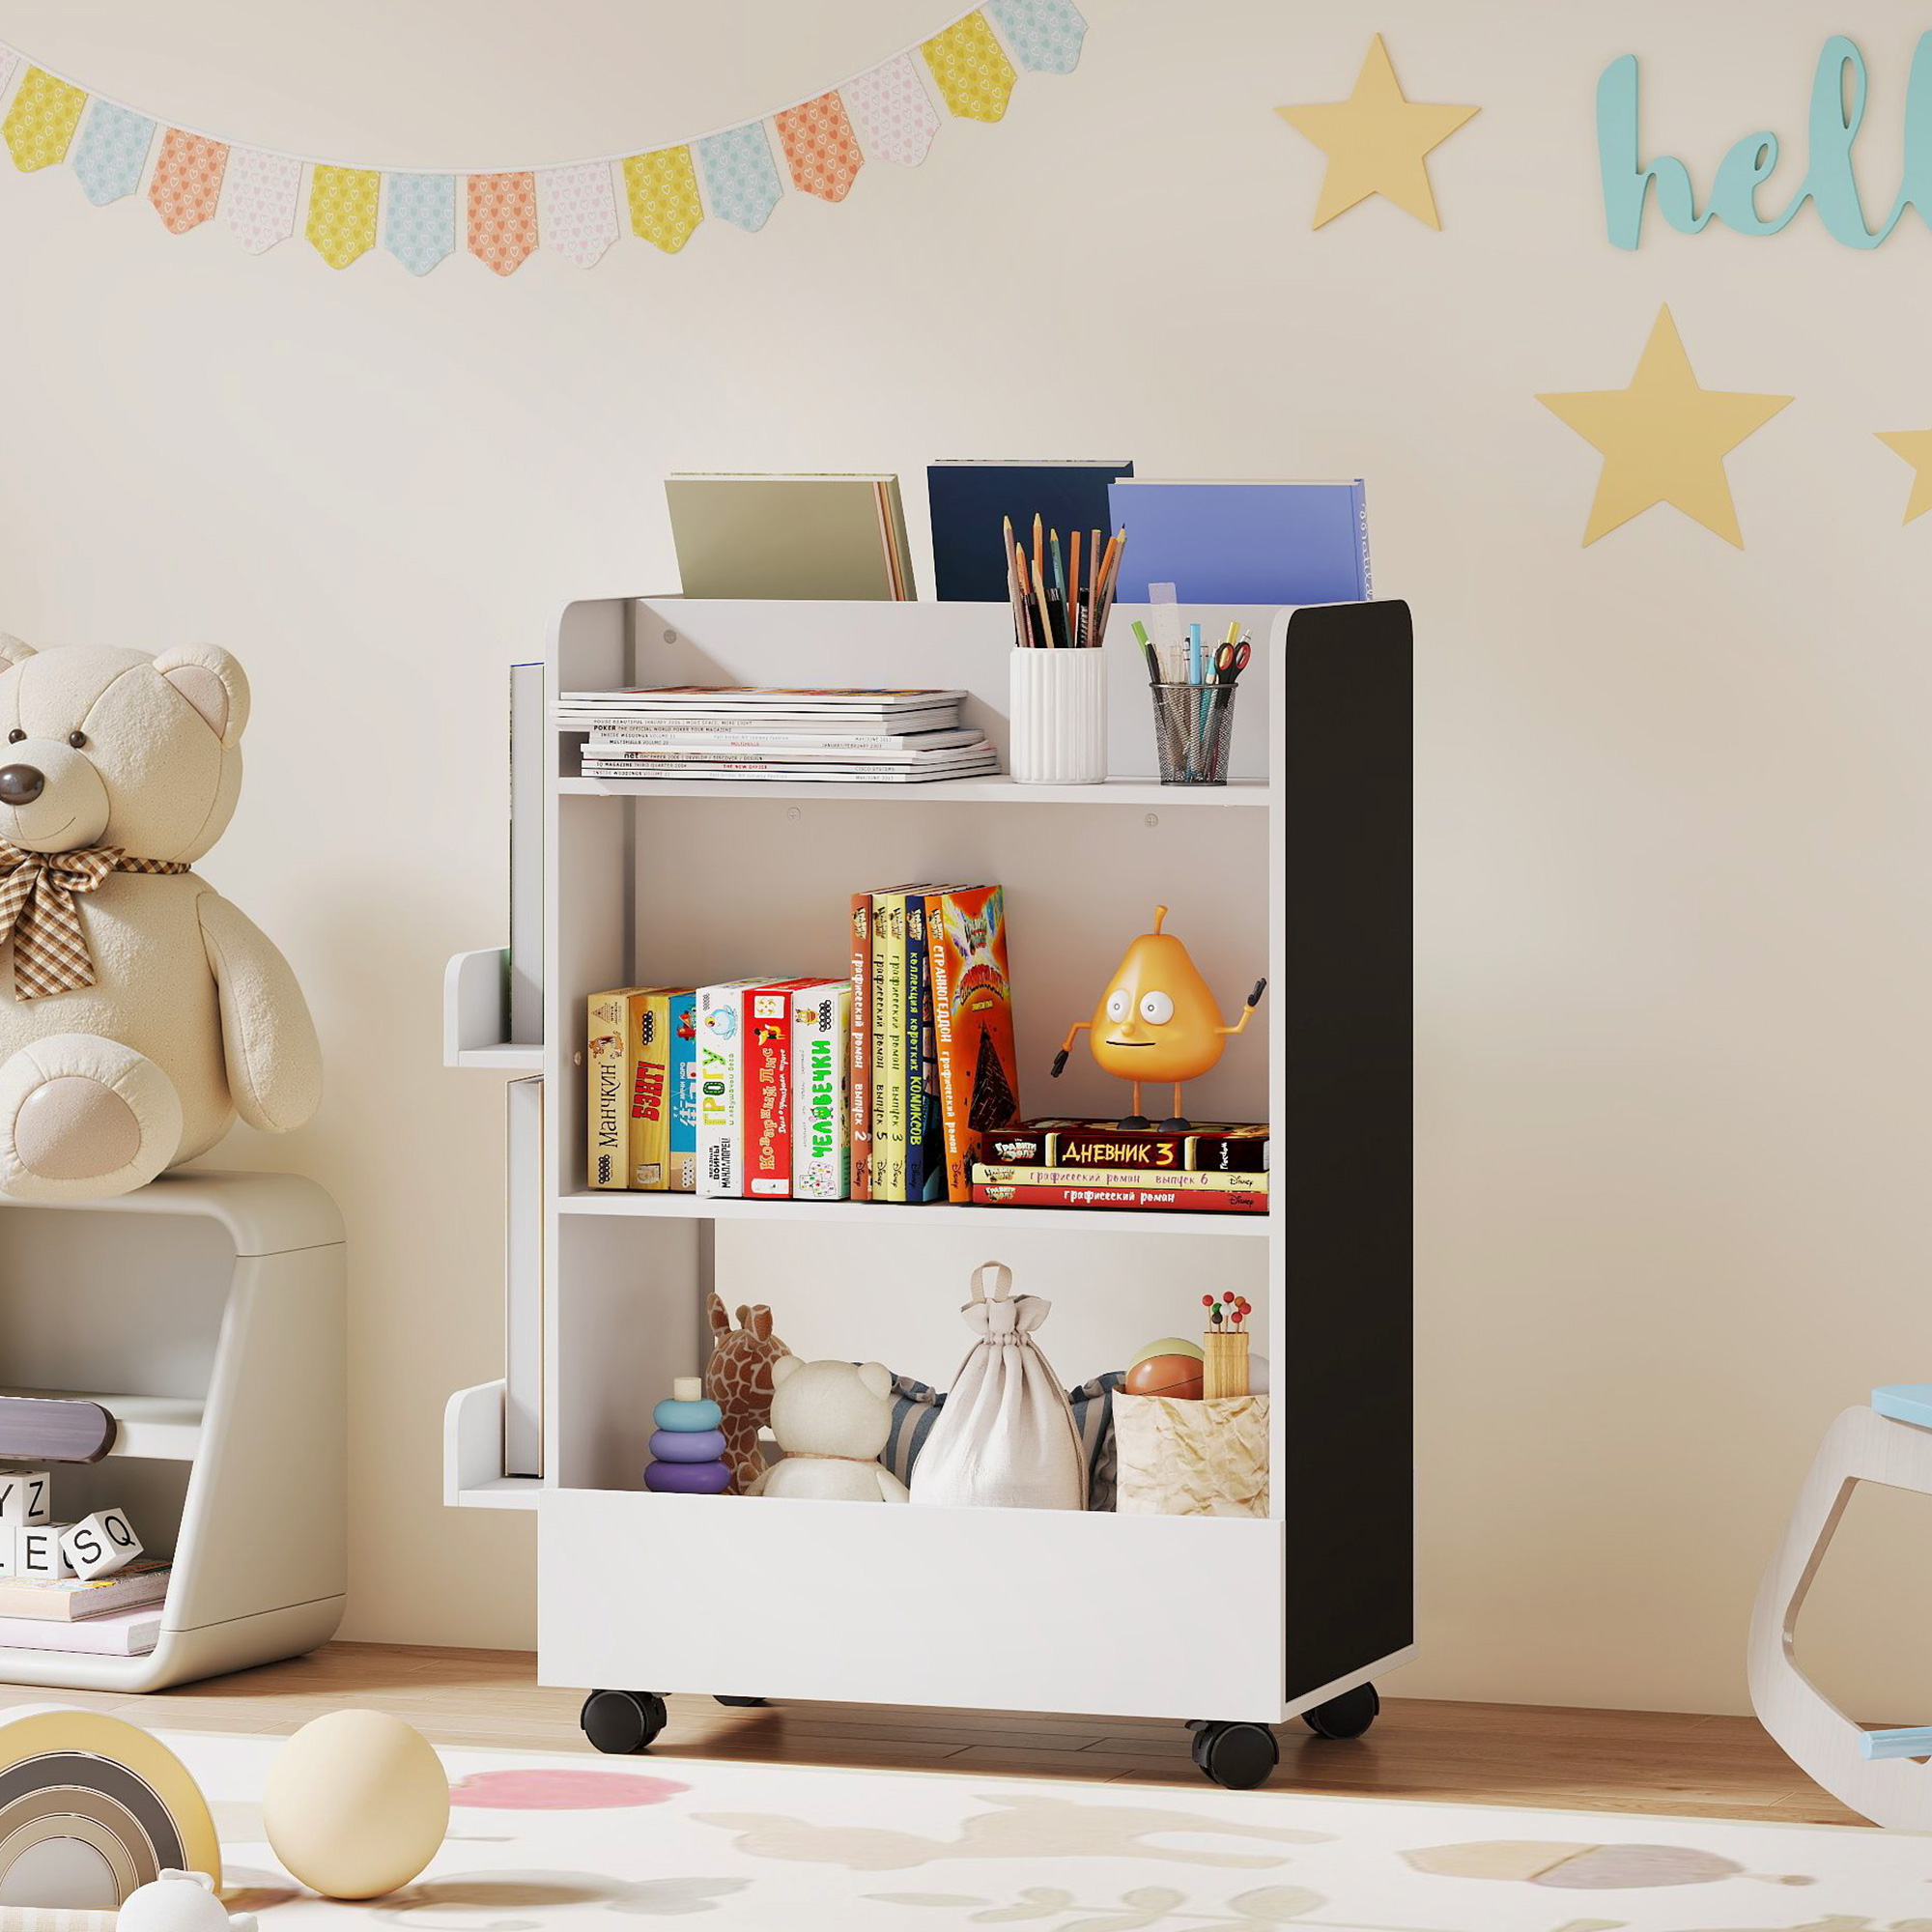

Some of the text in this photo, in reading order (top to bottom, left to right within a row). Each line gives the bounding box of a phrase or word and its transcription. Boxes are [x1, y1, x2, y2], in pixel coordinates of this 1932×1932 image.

[852, 1032, 864, 1069] роман
[873, 1033, 885, 1068] роман
[889, 1035, 900, 1070] роман
[907, 952, 923, 1146] коллекция коротких КОМИКСОВ
[933, 945, 952, 1043] СТРАННОГЕДДОН
[944, 1122, 957, 1153] роман
[631, 1060, 666, 1122] БЭНГ!
[702, 1047, 726, 1125] ГРОГУ
[810, 1039, 834, 1158] ЧЕЛОВЕЧКИ
[598, 1064, 621, 1148] Манчкин
[759, 1047, 778, 1171] Коварный Лис
[851, 1083, 864, 1125] выпуск
[855, 1131, 867, 1142] 2
[876, 1131, 888, 1141] 5
[892, 1133, 903, 1142] 3
[1062, 1141, 1174, 1165] ДНЕВНИК 3
[721, 1136, 731, 1189] МАНДАЛОРЕЦ
[853, 1159, 867, 1188] Disney
[874, 1159, 887, 1187] Disney
[892, 1159, 903, 1188] Disney
[950, 1160, 962, 1189] Disney
[1106, 1174, 1141, 1186] роман
[1155, 1175, 1195, 1186] выпуск
[1200, 1172, 1208, 1185] 6
[1140, 1192, 1176, 1205] роман
[1229, 1175, 1254, 1187] Disney
[1229, 1194, 1255, 1208] Disney
[28, 1481, 44, 1518] Z
[73, 1529, 101, 1564] S
[104, 1516, 136, 1547] Q
[26, 1535, 48, 1571] E
